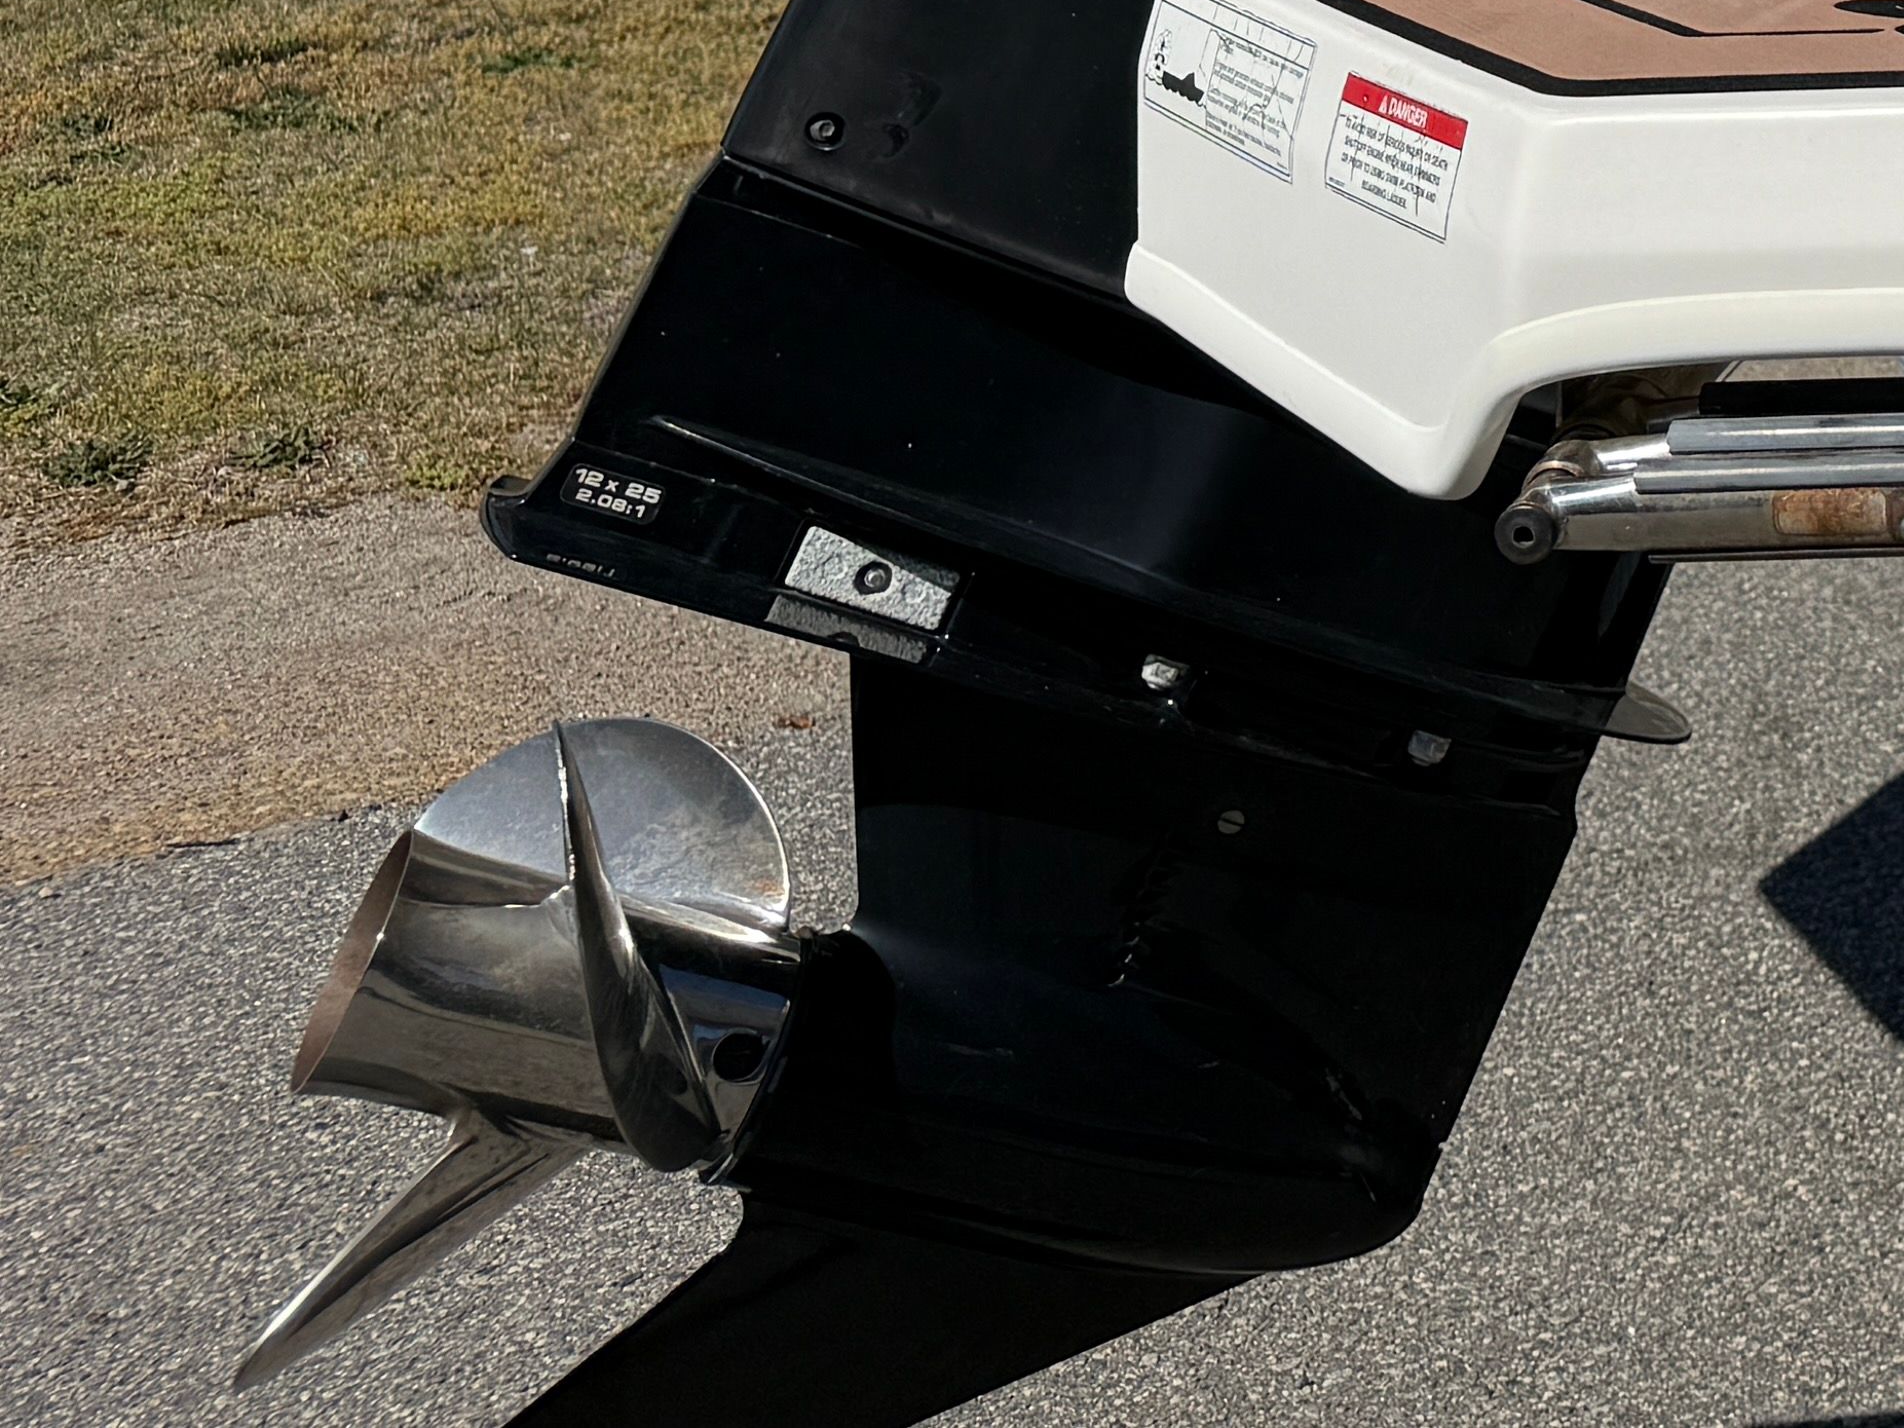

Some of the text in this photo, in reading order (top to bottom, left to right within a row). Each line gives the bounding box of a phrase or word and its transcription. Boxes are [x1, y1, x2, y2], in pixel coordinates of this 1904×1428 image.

[1387, 99, 1428, 129] DANGER
[575, 468, 662, 505] 12 x 25
[575, 488, 647, 519] 2.08:1
